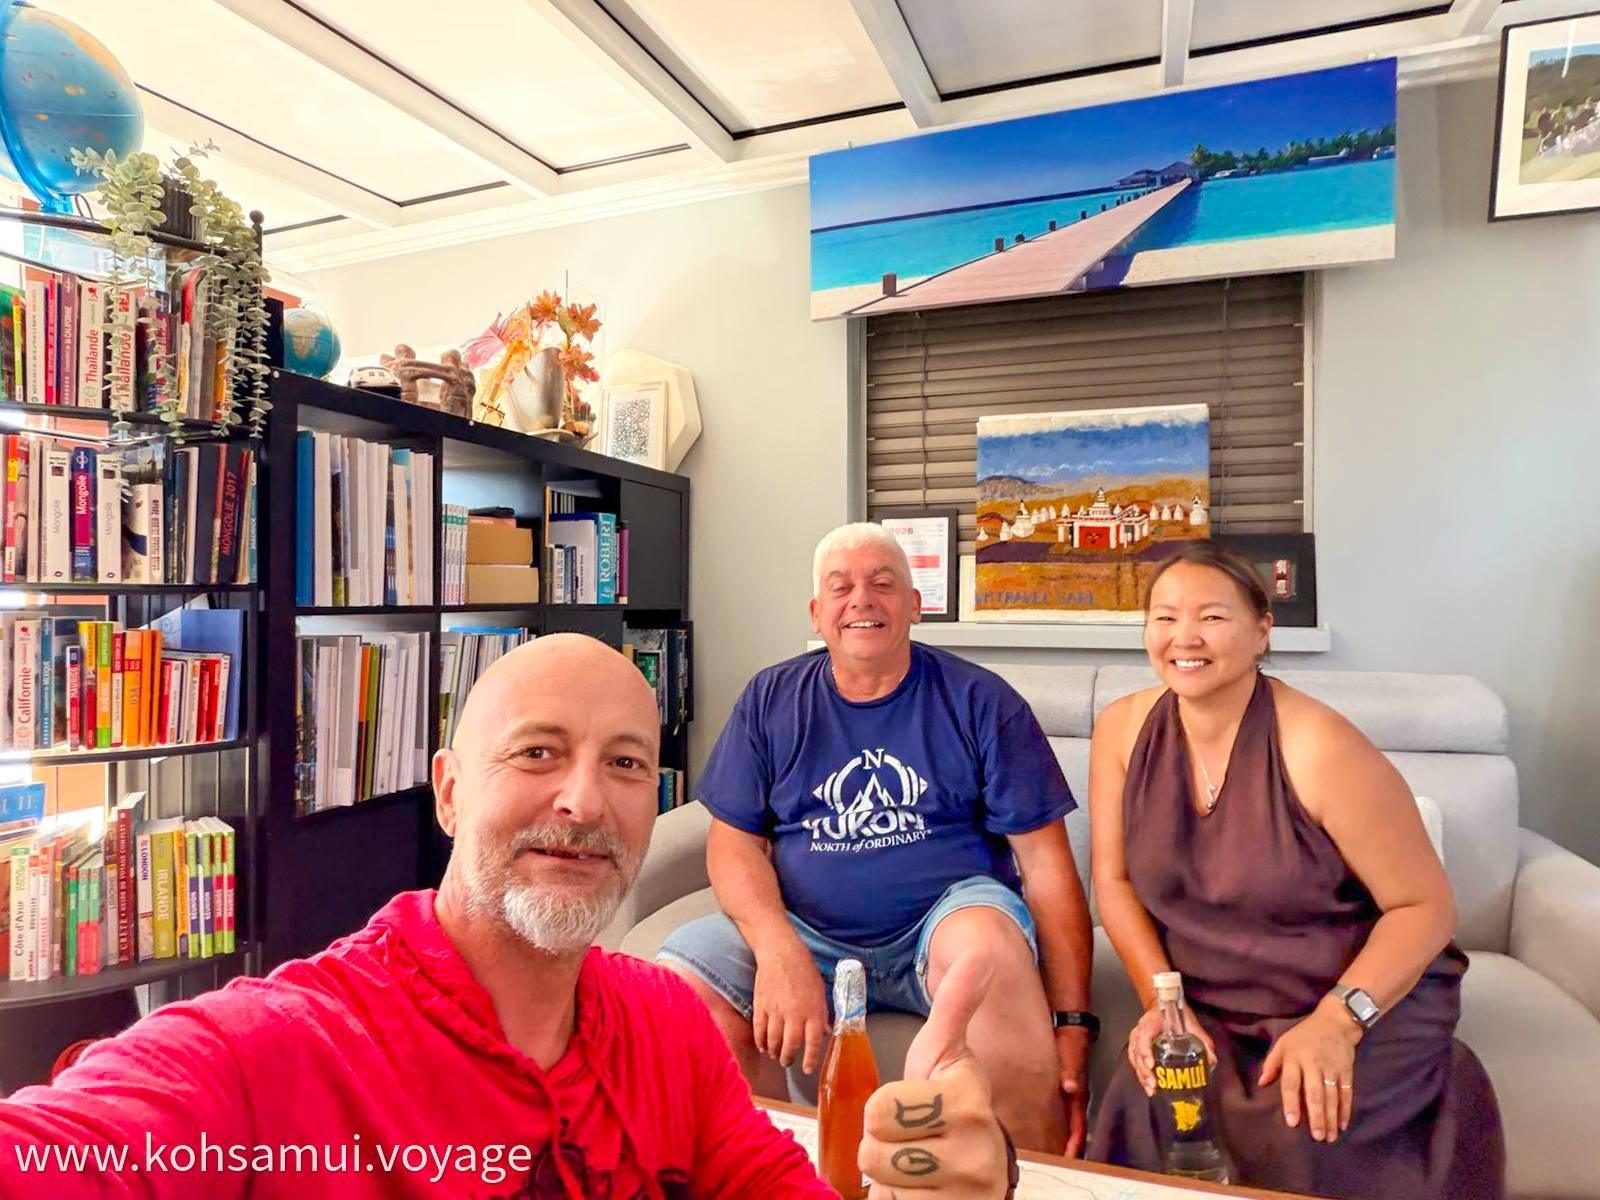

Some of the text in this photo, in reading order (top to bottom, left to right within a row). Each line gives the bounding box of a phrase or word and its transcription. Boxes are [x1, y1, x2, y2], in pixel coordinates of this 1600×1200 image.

[63, 306, 73, 338] CALIFORNIE
[75, 475, 90, 515] Mongolie
[53, 498, 63, 535] Mongolie
[103, 501, 114, 536] Mongolie
[221, 471, 238, 556] MONGOLIE 2017
[599, 520, 611, 582] ROBERT
[17, 666, 33, 724] Californie
[862, 748, 885, 770] N
[118, 823, 127, 854] COMPLET
[802, 808, 925, 840] YUKON
[810, 831, 927, 853] NORTH of ORDINARY
[119, 854, 128, 879] VOYAGE
[141, 847, 149, 881] LONDON
[120, 881, 128, 889] DE
[120, 891, 128, 912] GUIDE
[156, 868, 169, 920] IRLANDE
[14, 900, 25, 957] Côte d'Azur
